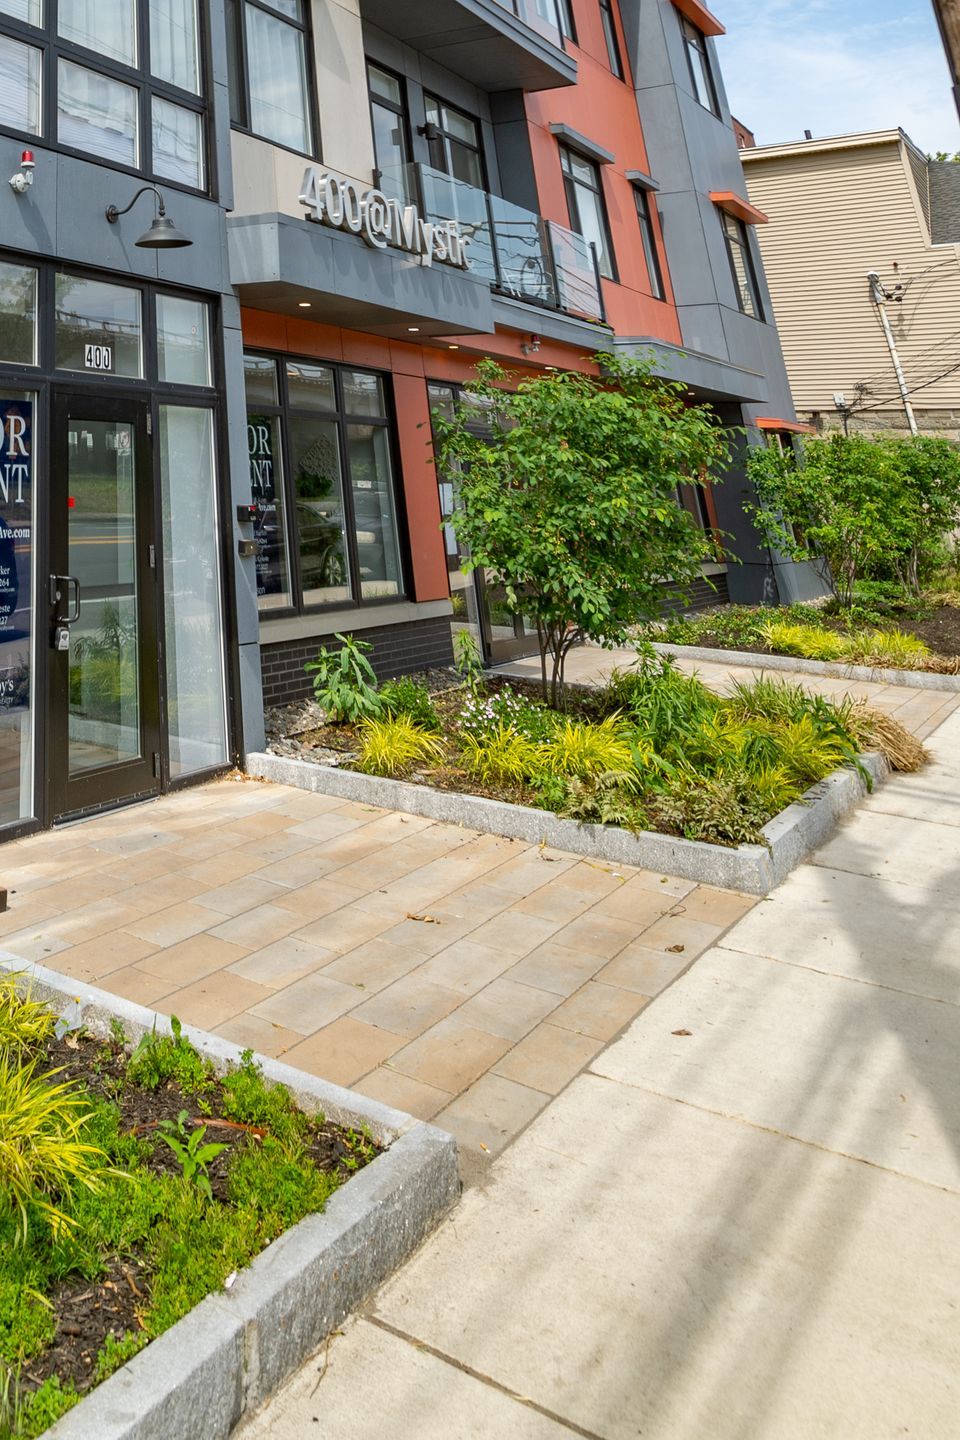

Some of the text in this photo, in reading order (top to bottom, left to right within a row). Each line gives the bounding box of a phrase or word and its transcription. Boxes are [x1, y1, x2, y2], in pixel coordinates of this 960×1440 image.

[298, 166, 472, 268] 400@Mystic
[86, 347, 110, 369] 400
[247, 424, 271, 455] OR
[250, 460, 272, 487] NT
